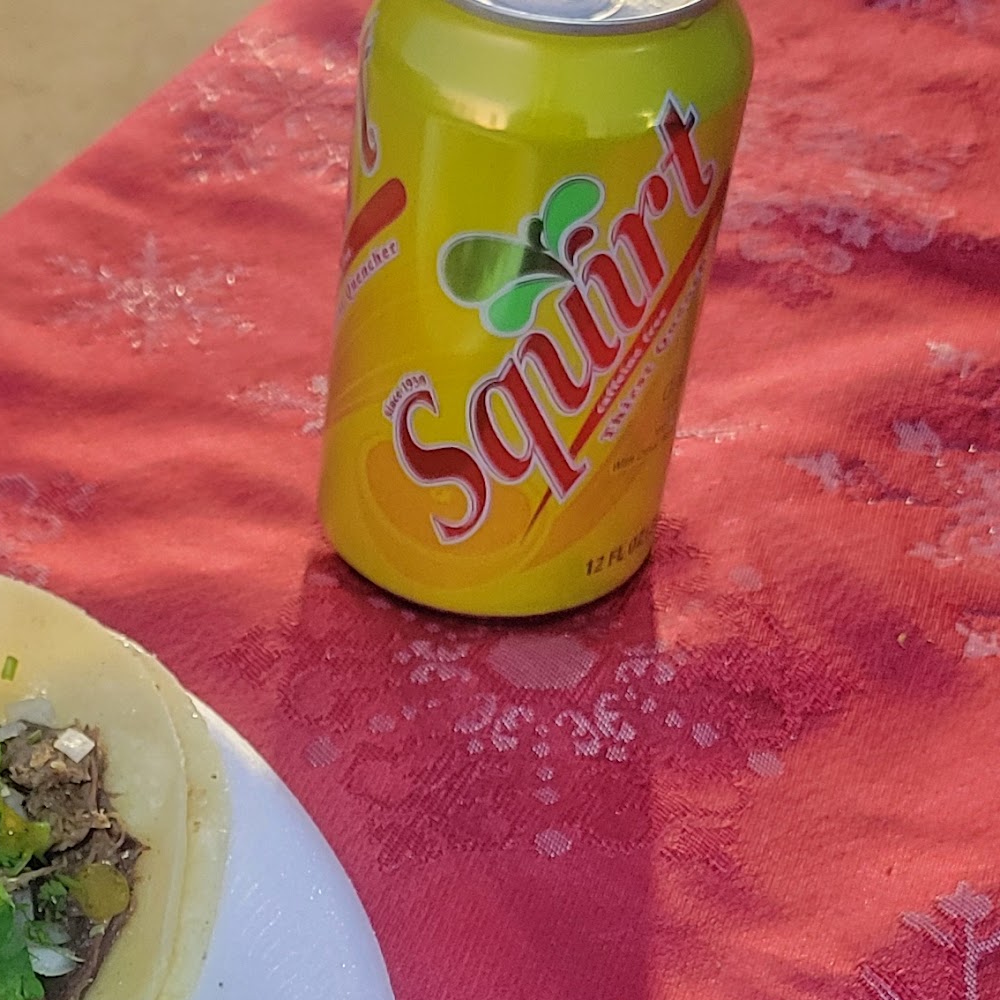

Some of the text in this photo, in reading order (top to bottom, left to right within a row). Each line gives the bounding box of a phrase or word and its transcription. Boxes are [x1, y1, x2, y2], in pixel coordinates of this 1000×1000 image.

[393, 91, 715, 544] Squirt
[586, 556, 604, 576] 12
[608, 545, 624, 567] FL
